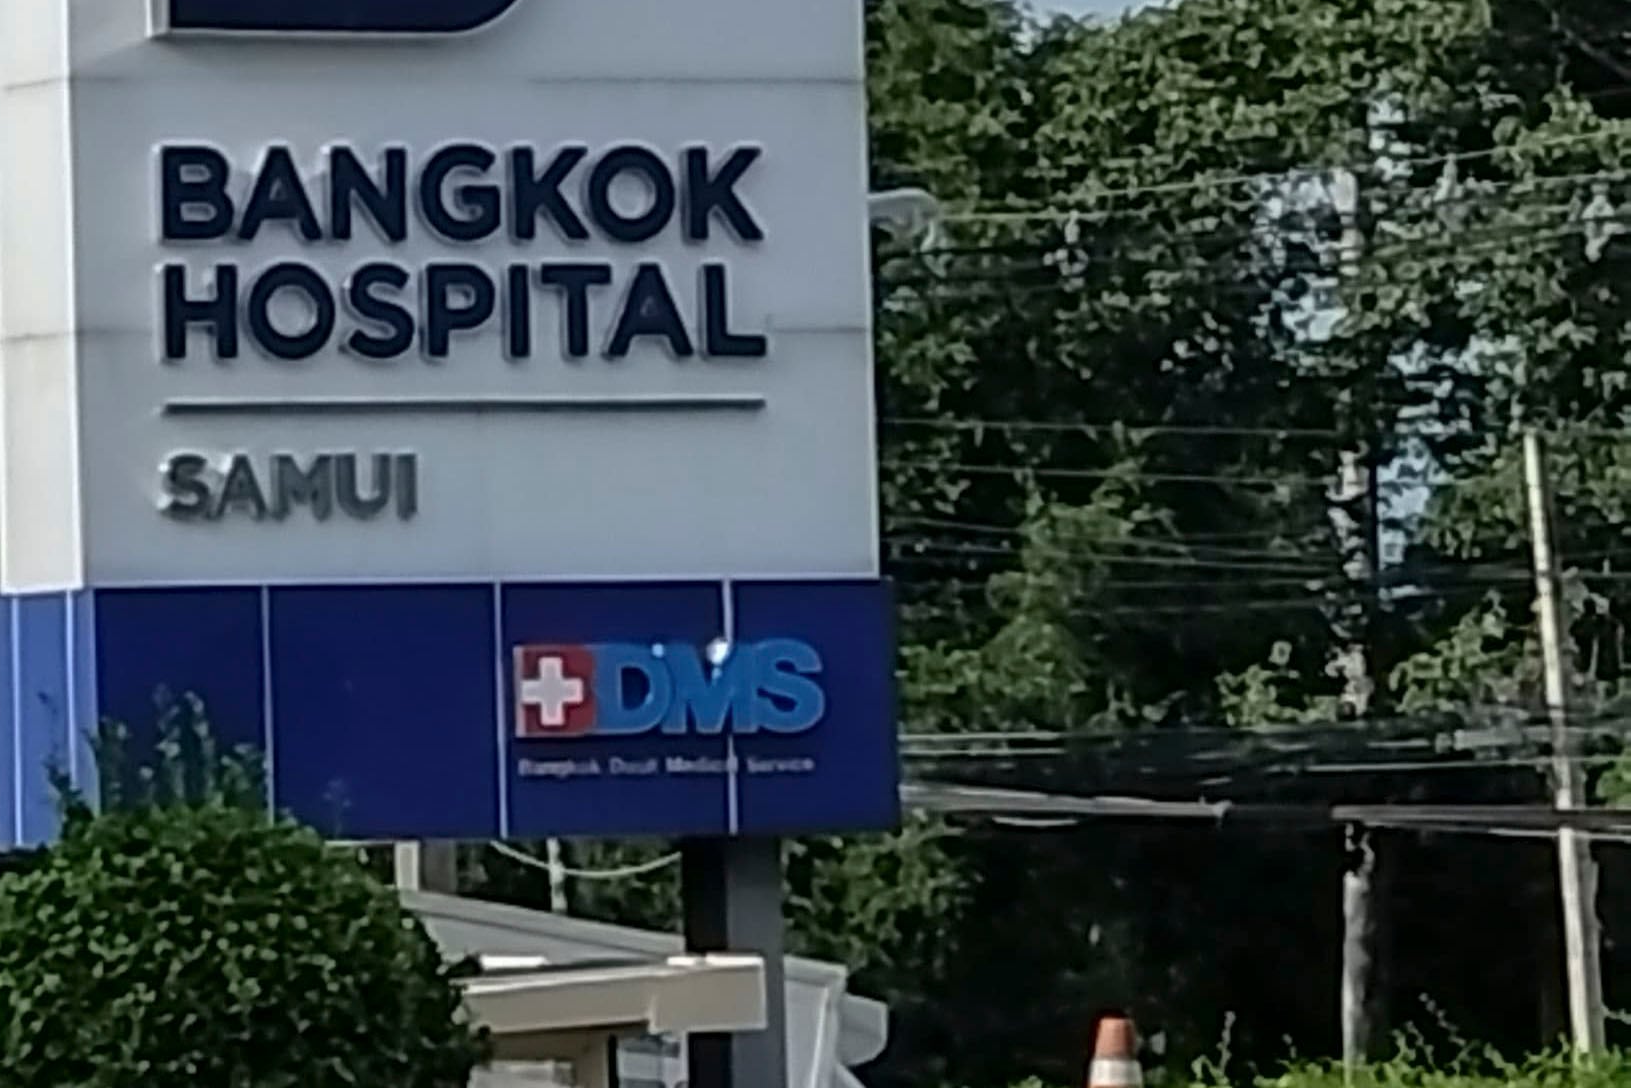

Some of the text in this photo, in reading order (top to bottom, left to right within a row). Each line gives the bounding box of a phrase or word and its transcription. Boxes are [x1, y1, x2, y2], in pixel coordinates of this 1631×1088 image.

[160, 143, 764, 243] BANGKOK
[162, 261, 767, 360] HOSPITAL
[162, 452, 419, 520] SAMUI
